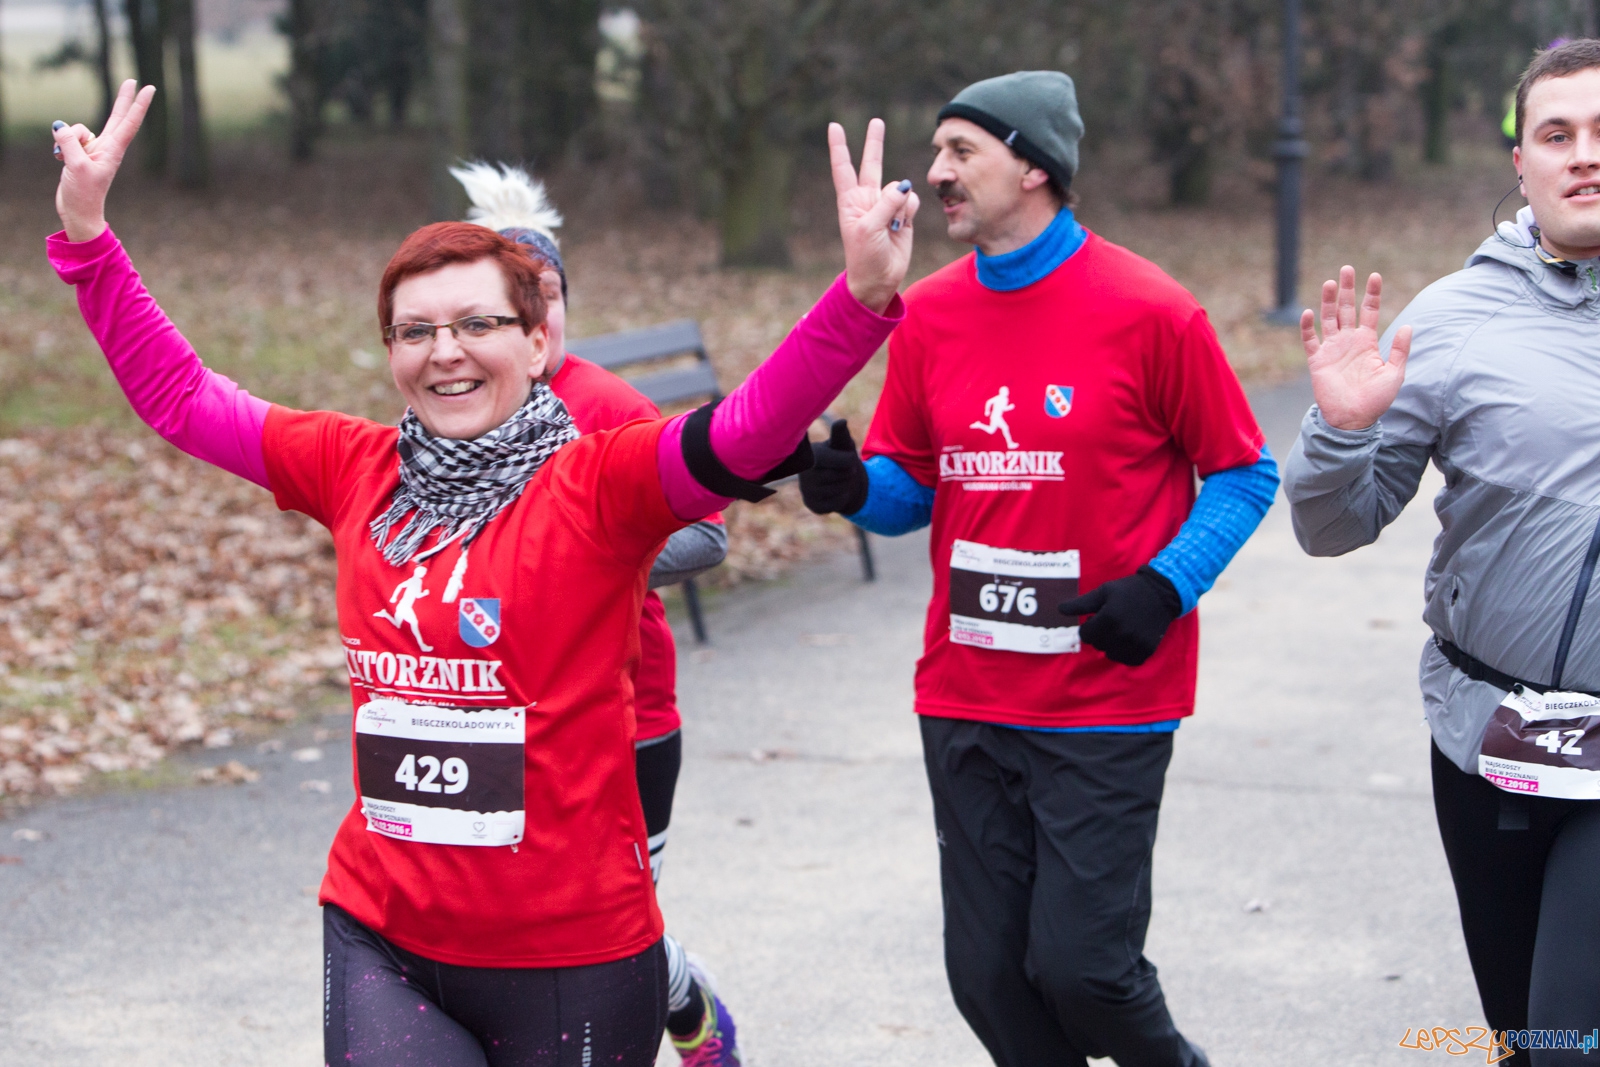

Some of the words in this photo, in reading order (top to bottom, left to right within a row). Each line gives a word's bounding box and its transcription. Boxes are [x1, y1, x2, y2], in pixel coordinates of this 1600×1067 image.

[979, 583, 1038, 616] 676
[1545, 700, 1600, 710] BIEGCZEKOLA
[411, 718, 516, 730] BIEGCZEKOLADOWY.PL
[1535, 729, 1585, 755] 42
[395, 754, 469, 794] 429
